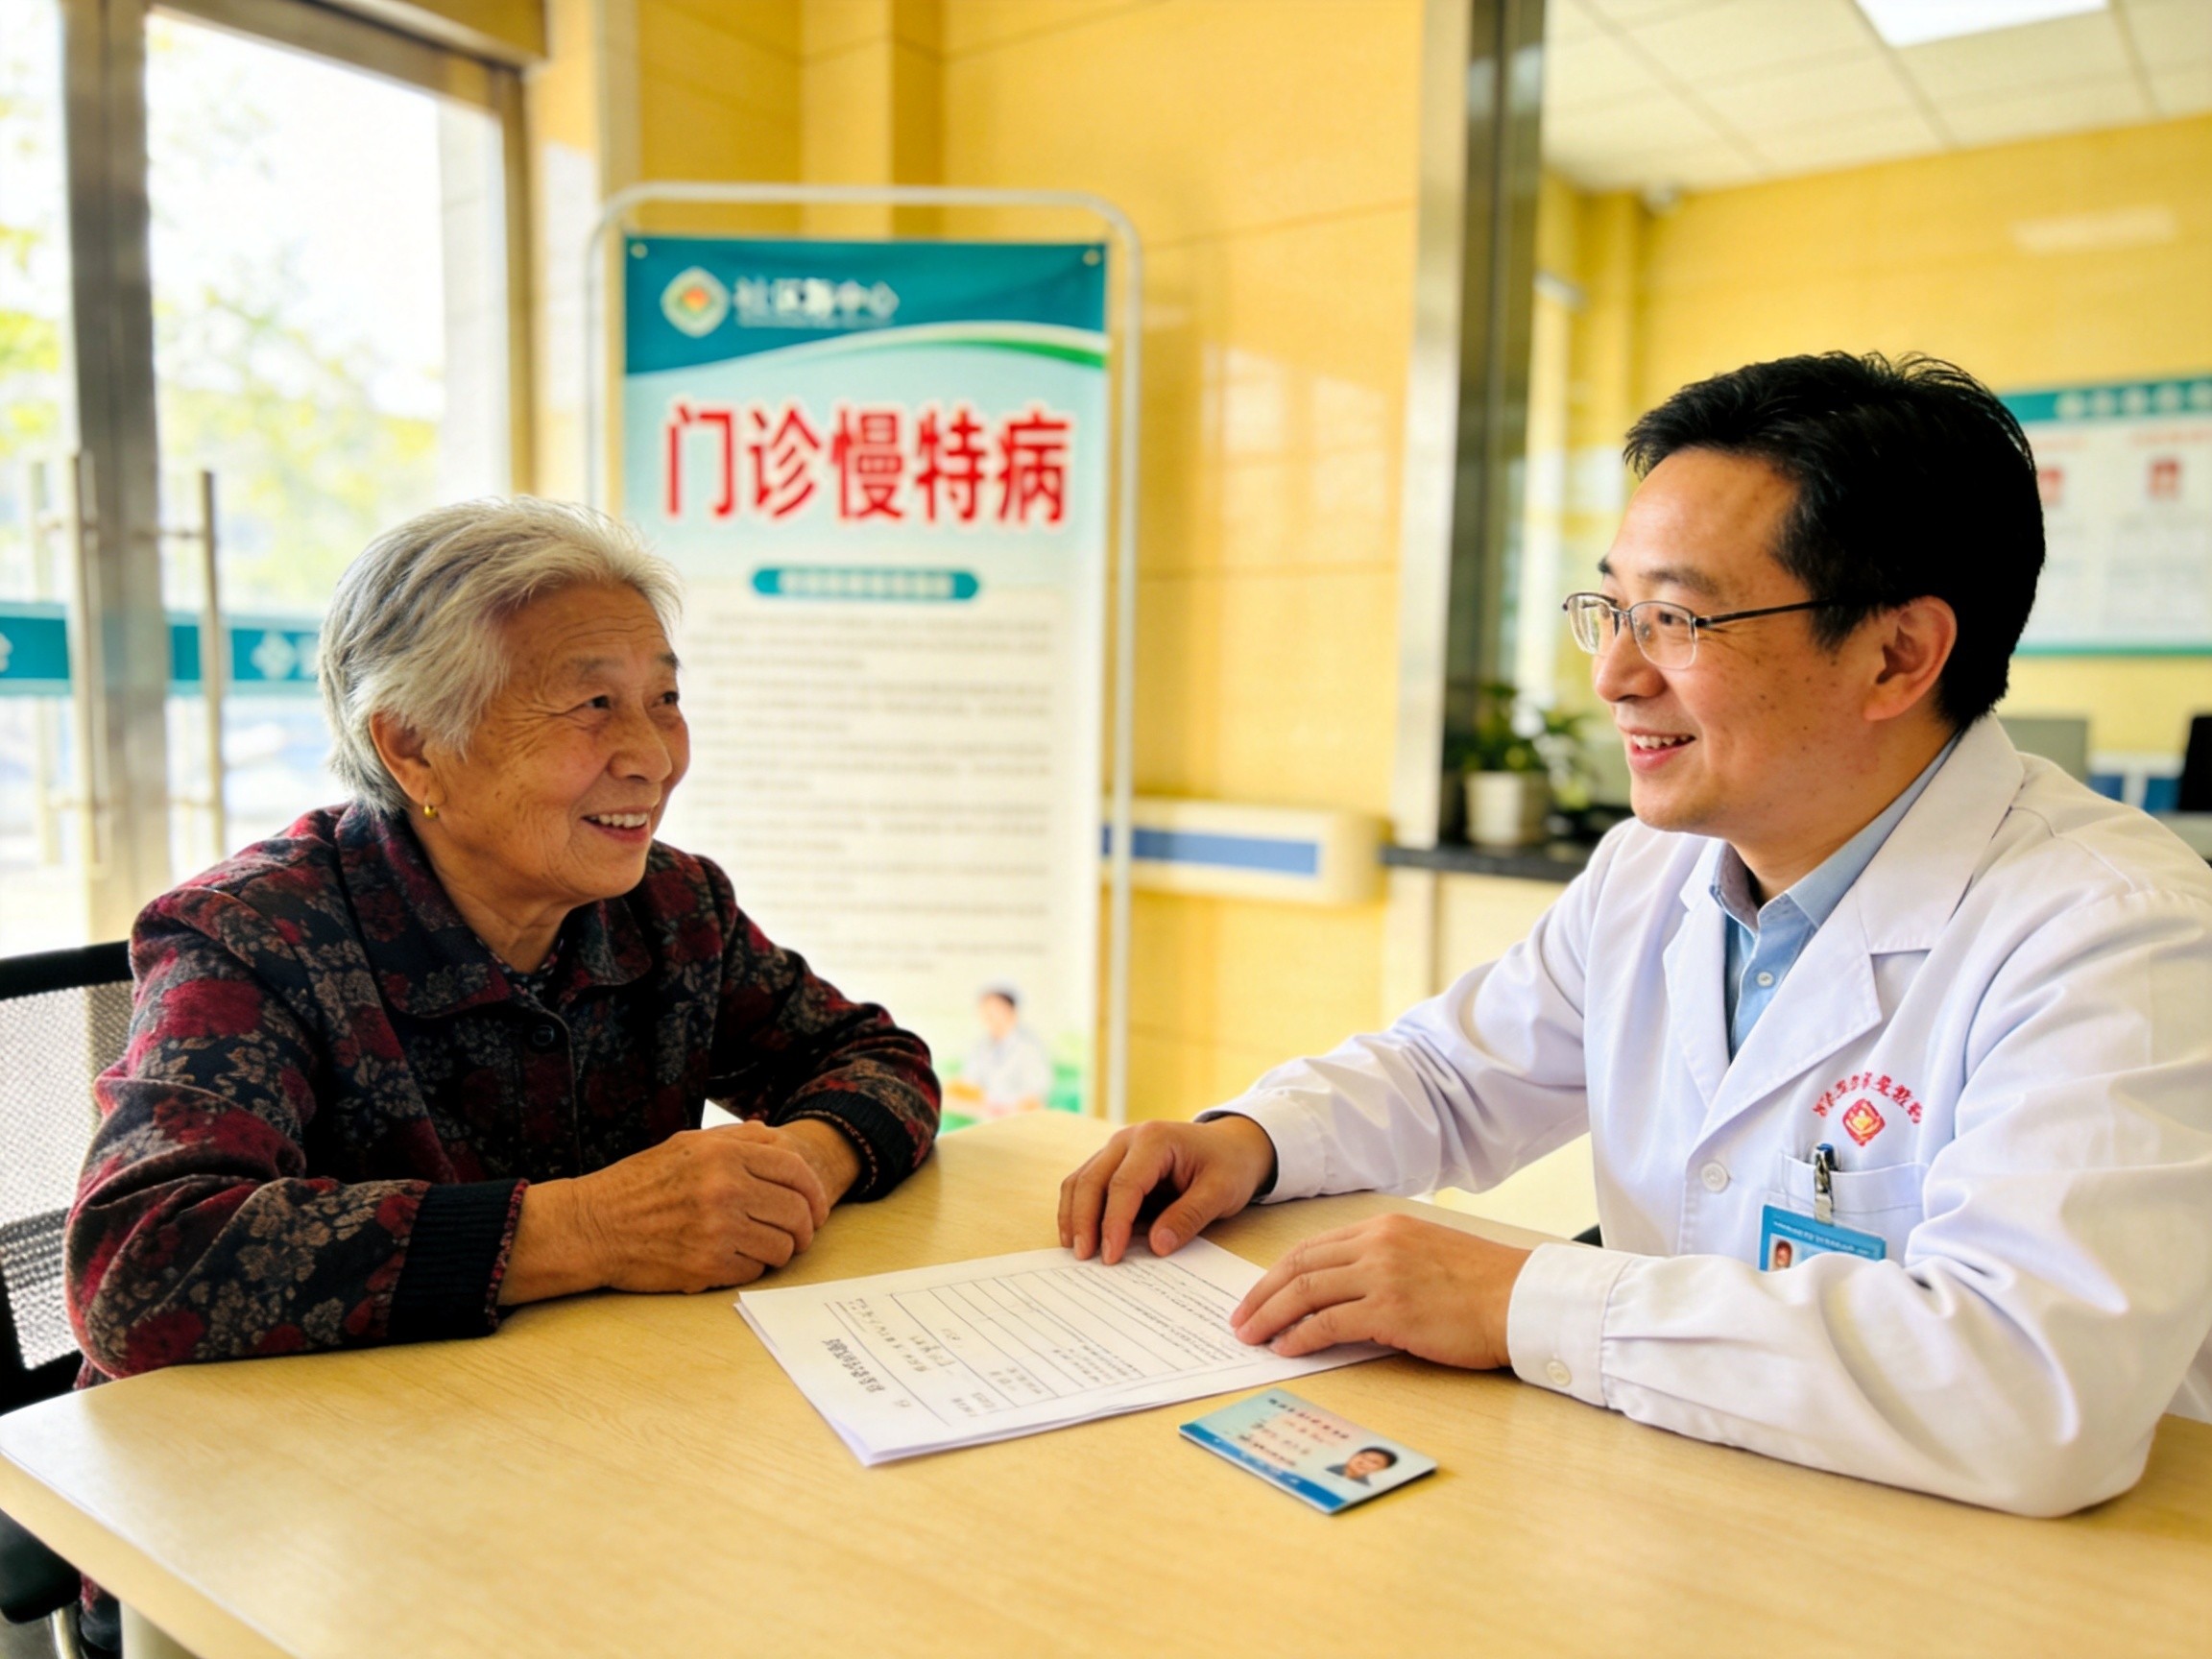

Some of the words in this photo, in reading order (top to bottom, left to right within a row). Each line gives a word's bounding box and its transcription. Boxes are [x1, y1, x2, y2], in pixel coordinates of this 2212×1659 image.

[665, 404, 1071, 524] 门诊慢特病
